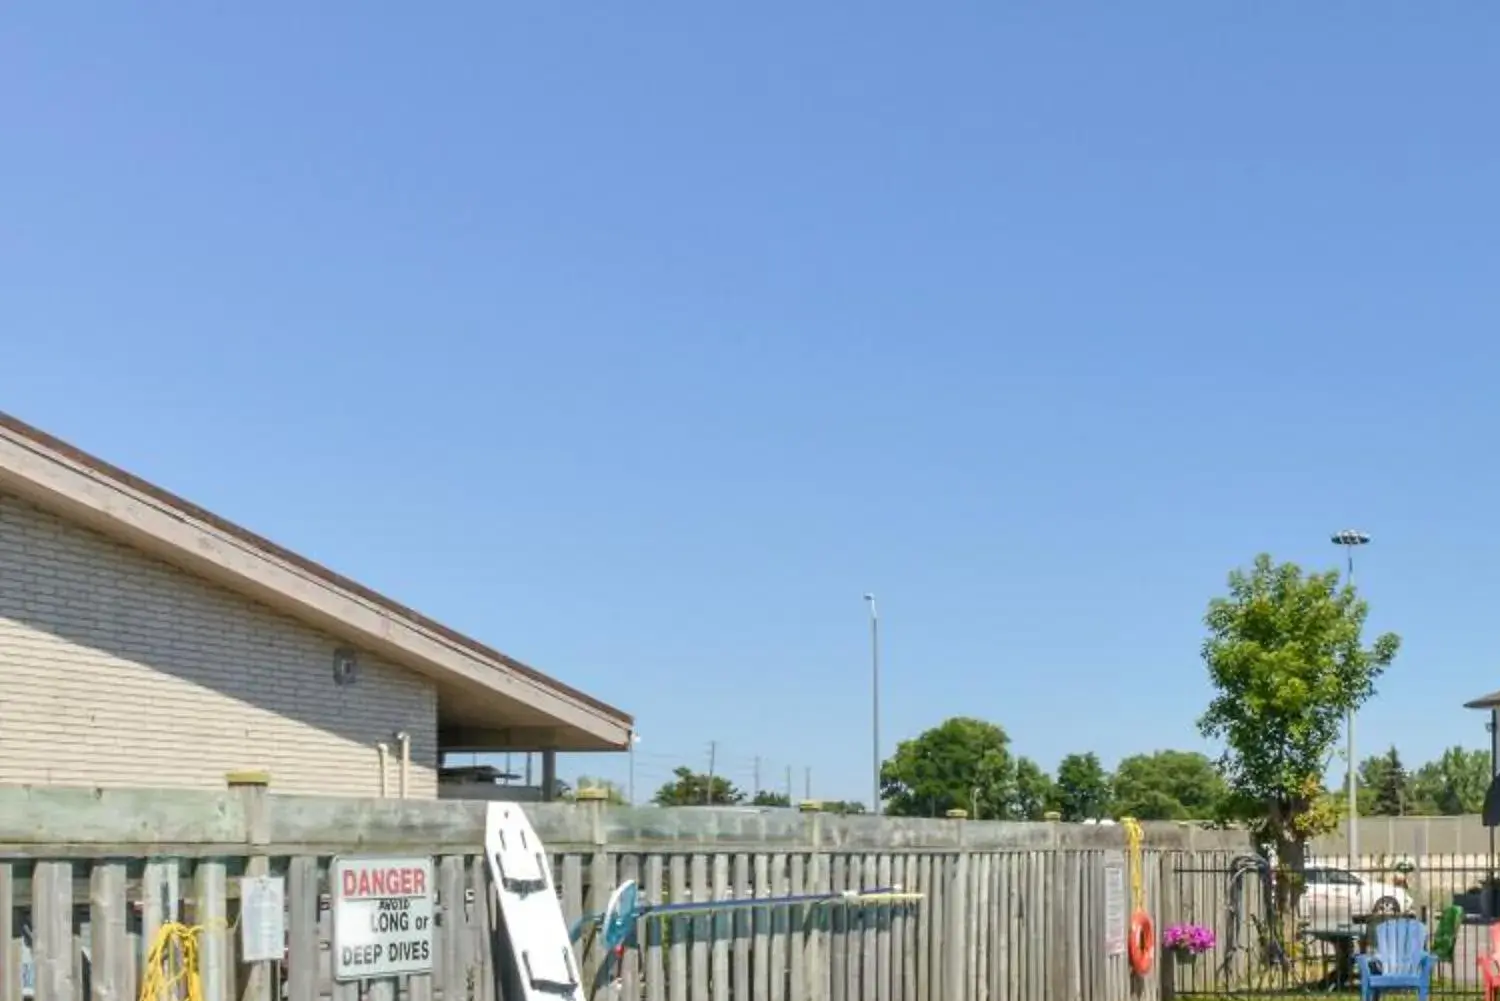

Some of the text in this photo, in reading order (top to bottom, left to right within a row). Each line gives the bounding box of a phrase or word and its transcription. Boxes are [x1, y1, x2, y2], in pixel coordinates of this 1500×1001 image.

[343, 868, 425, 896] DANGER
[371, 911, 429, 933] LONG or
[343, 940, 430, 966] DEEP DIVES
